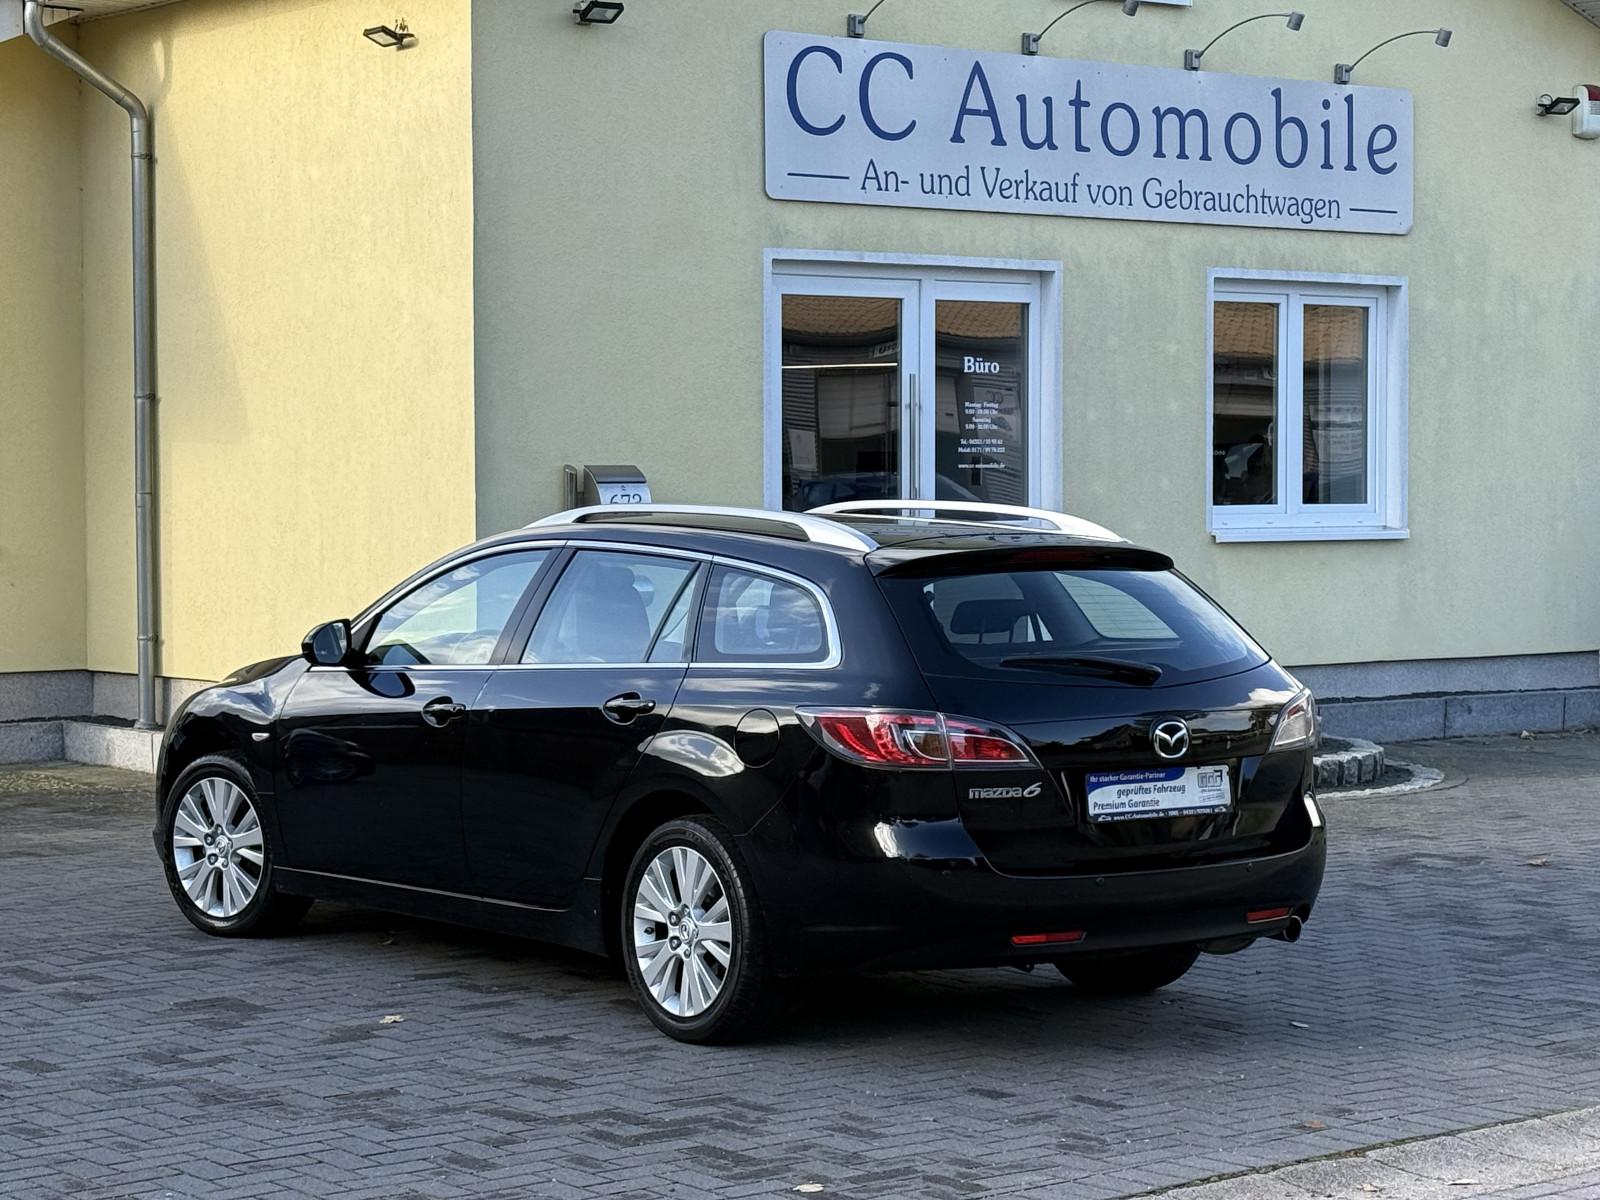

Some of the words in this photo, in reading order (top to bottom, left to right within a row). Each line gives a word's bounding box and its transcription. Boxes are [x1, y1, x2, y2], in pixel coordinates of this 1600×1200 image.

[786, 46, 918, 142] CC
[949, 61, 1398, 176] Automobile
[860, 158, 911, 193] An-
[919, 164, 971, 198] und
[979, 167, 1080, 204] Verkauf
[1086, 183, 1133, 207] von
[1142, 177, 1341, 225] Gebrauchtwagen
[964, 357, 1000, 373] Büro
[1116, 785, 1152, 798] geprüftes
[1153, 784, 1186, 795] Fahrzeug
[1093, 800, 1127, 811] Premium
[1127, 798, 1160, 809] Garantie
